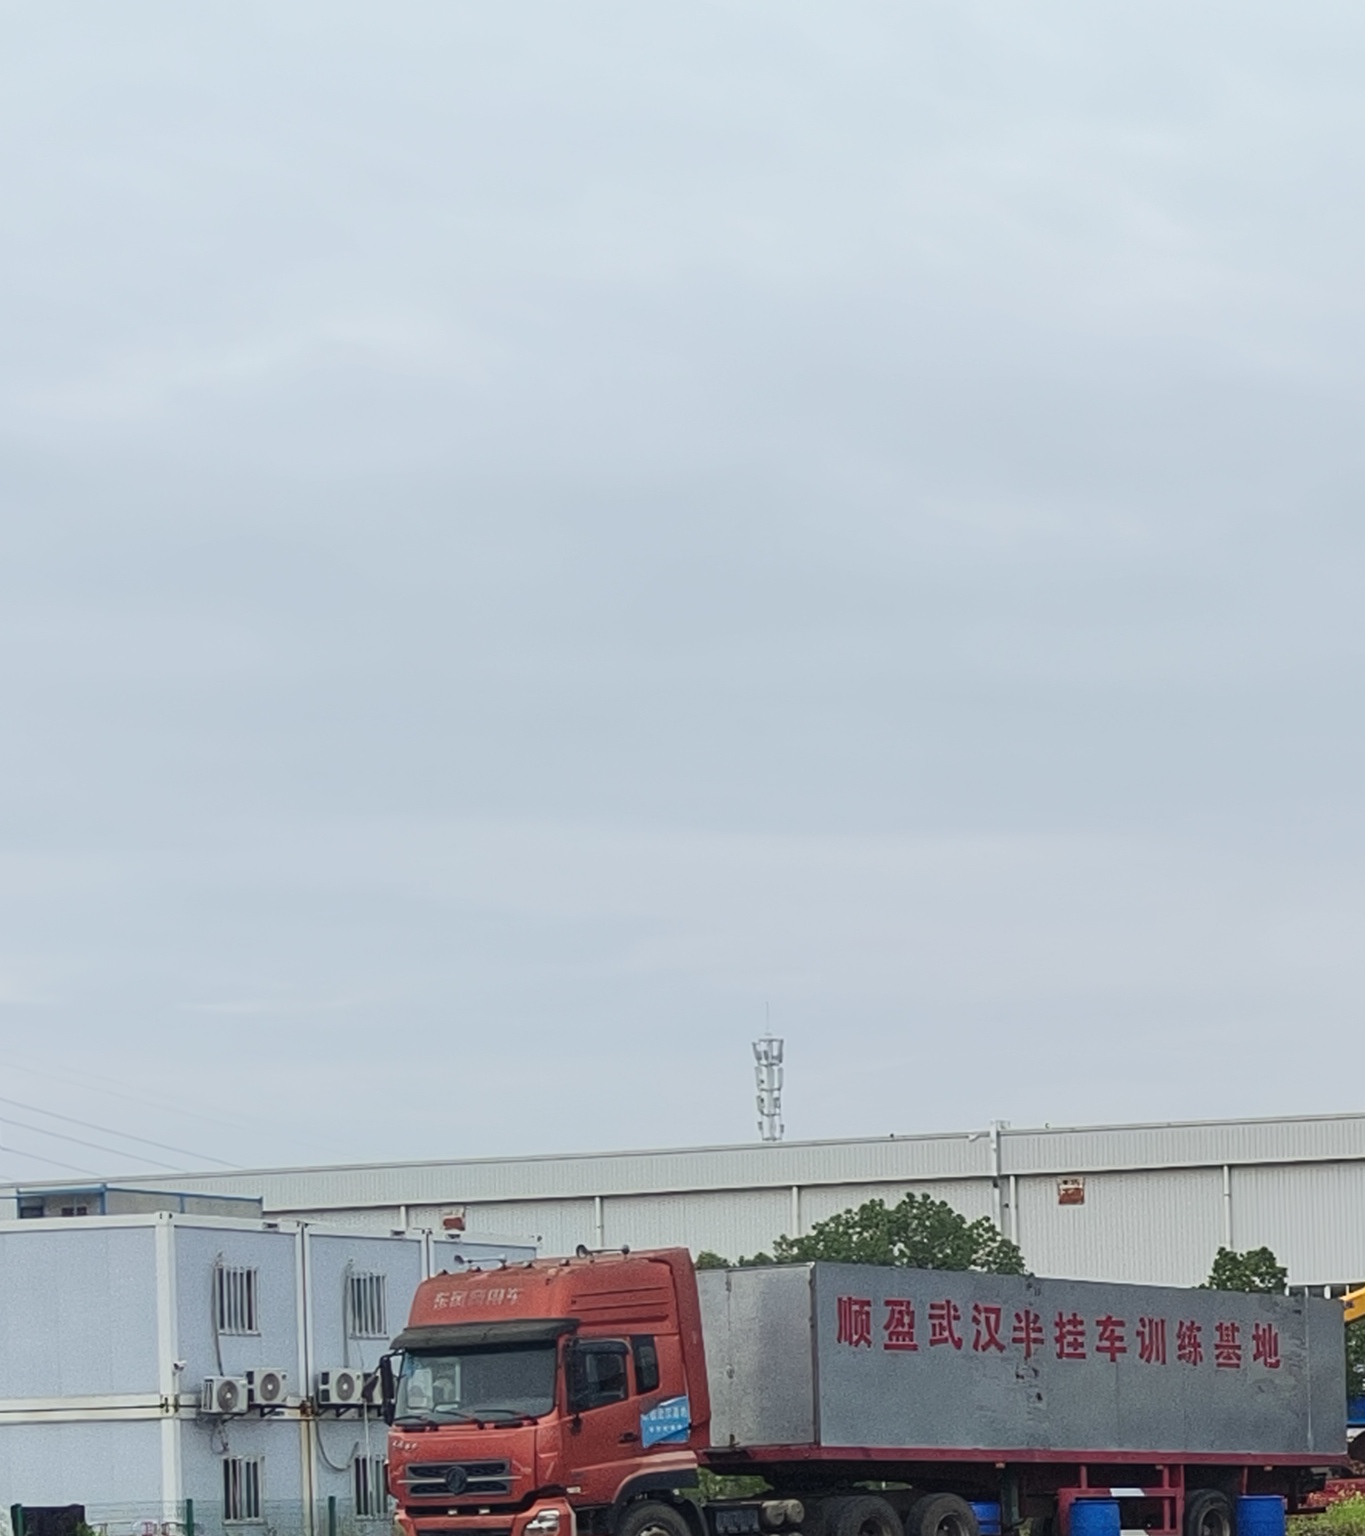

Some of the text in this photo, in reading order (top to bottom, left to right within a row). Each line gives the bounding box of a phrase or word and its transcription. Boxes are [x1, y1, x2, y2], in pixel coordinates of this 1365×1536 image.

[836, 1296, 1281, 1369] 顺盈武汉半挂车训练基地
